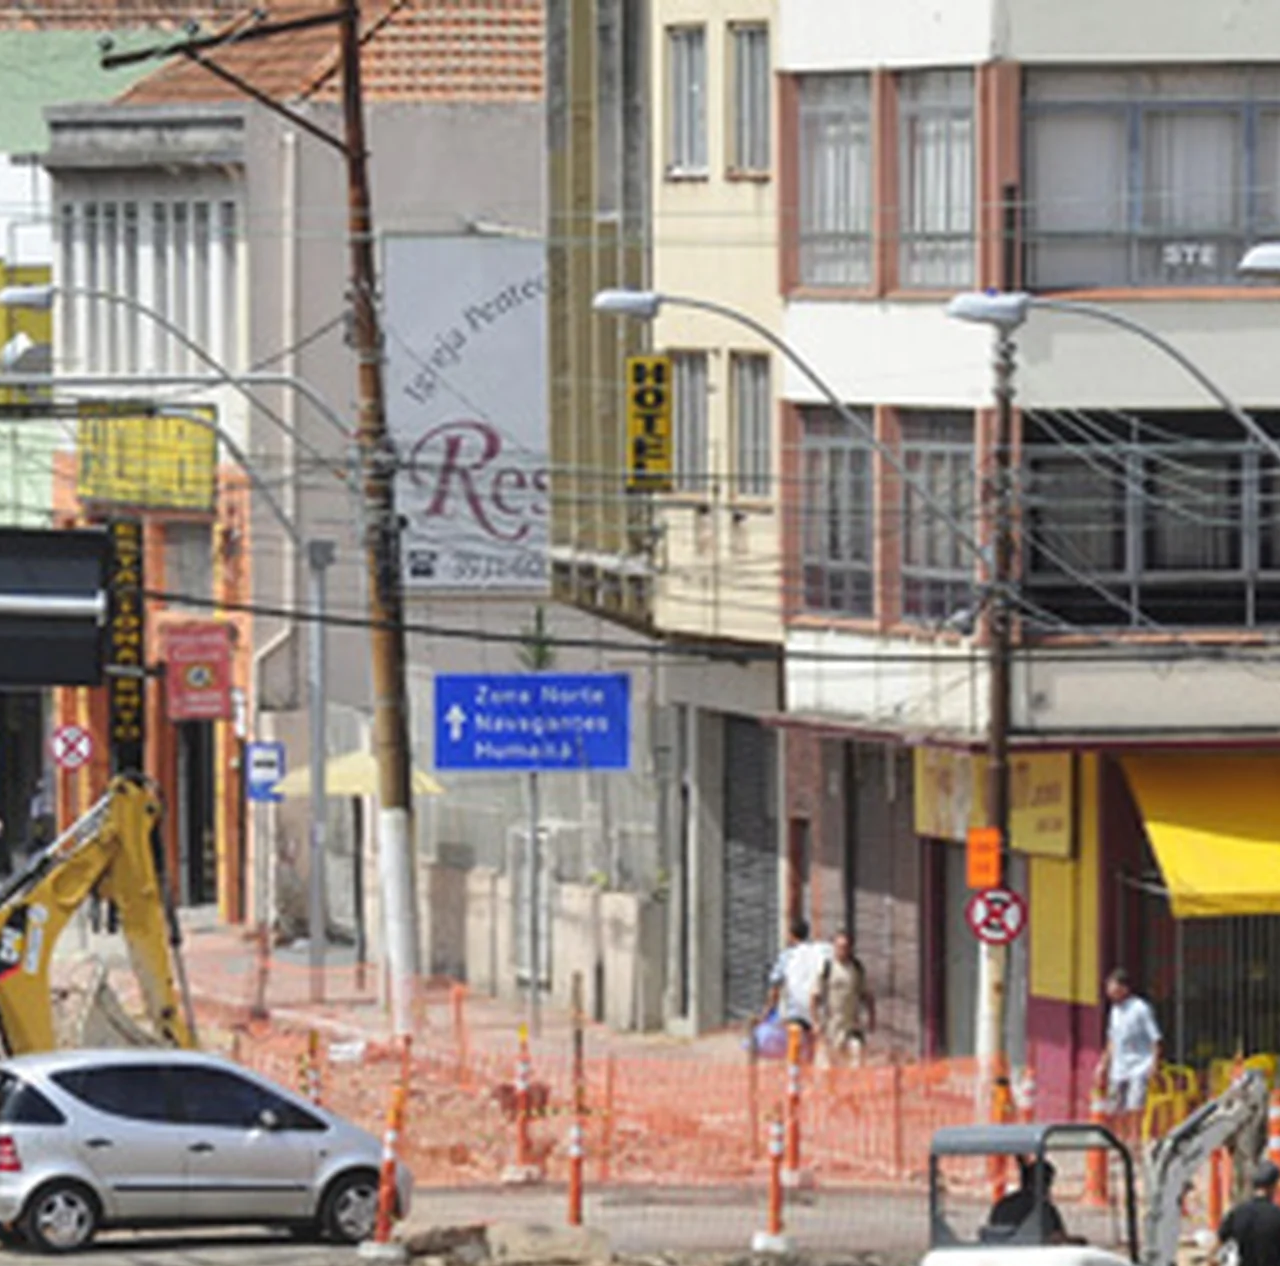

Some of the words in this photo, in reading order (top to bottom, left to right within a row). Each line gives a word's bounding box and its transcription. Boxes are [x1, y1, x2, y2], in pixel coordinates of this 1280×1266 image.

[633, 362, 664, 478] HOTEL
[113, 524, 139, 739] ESTACIONAENTO
[541, 686, 604, 704] Norte
